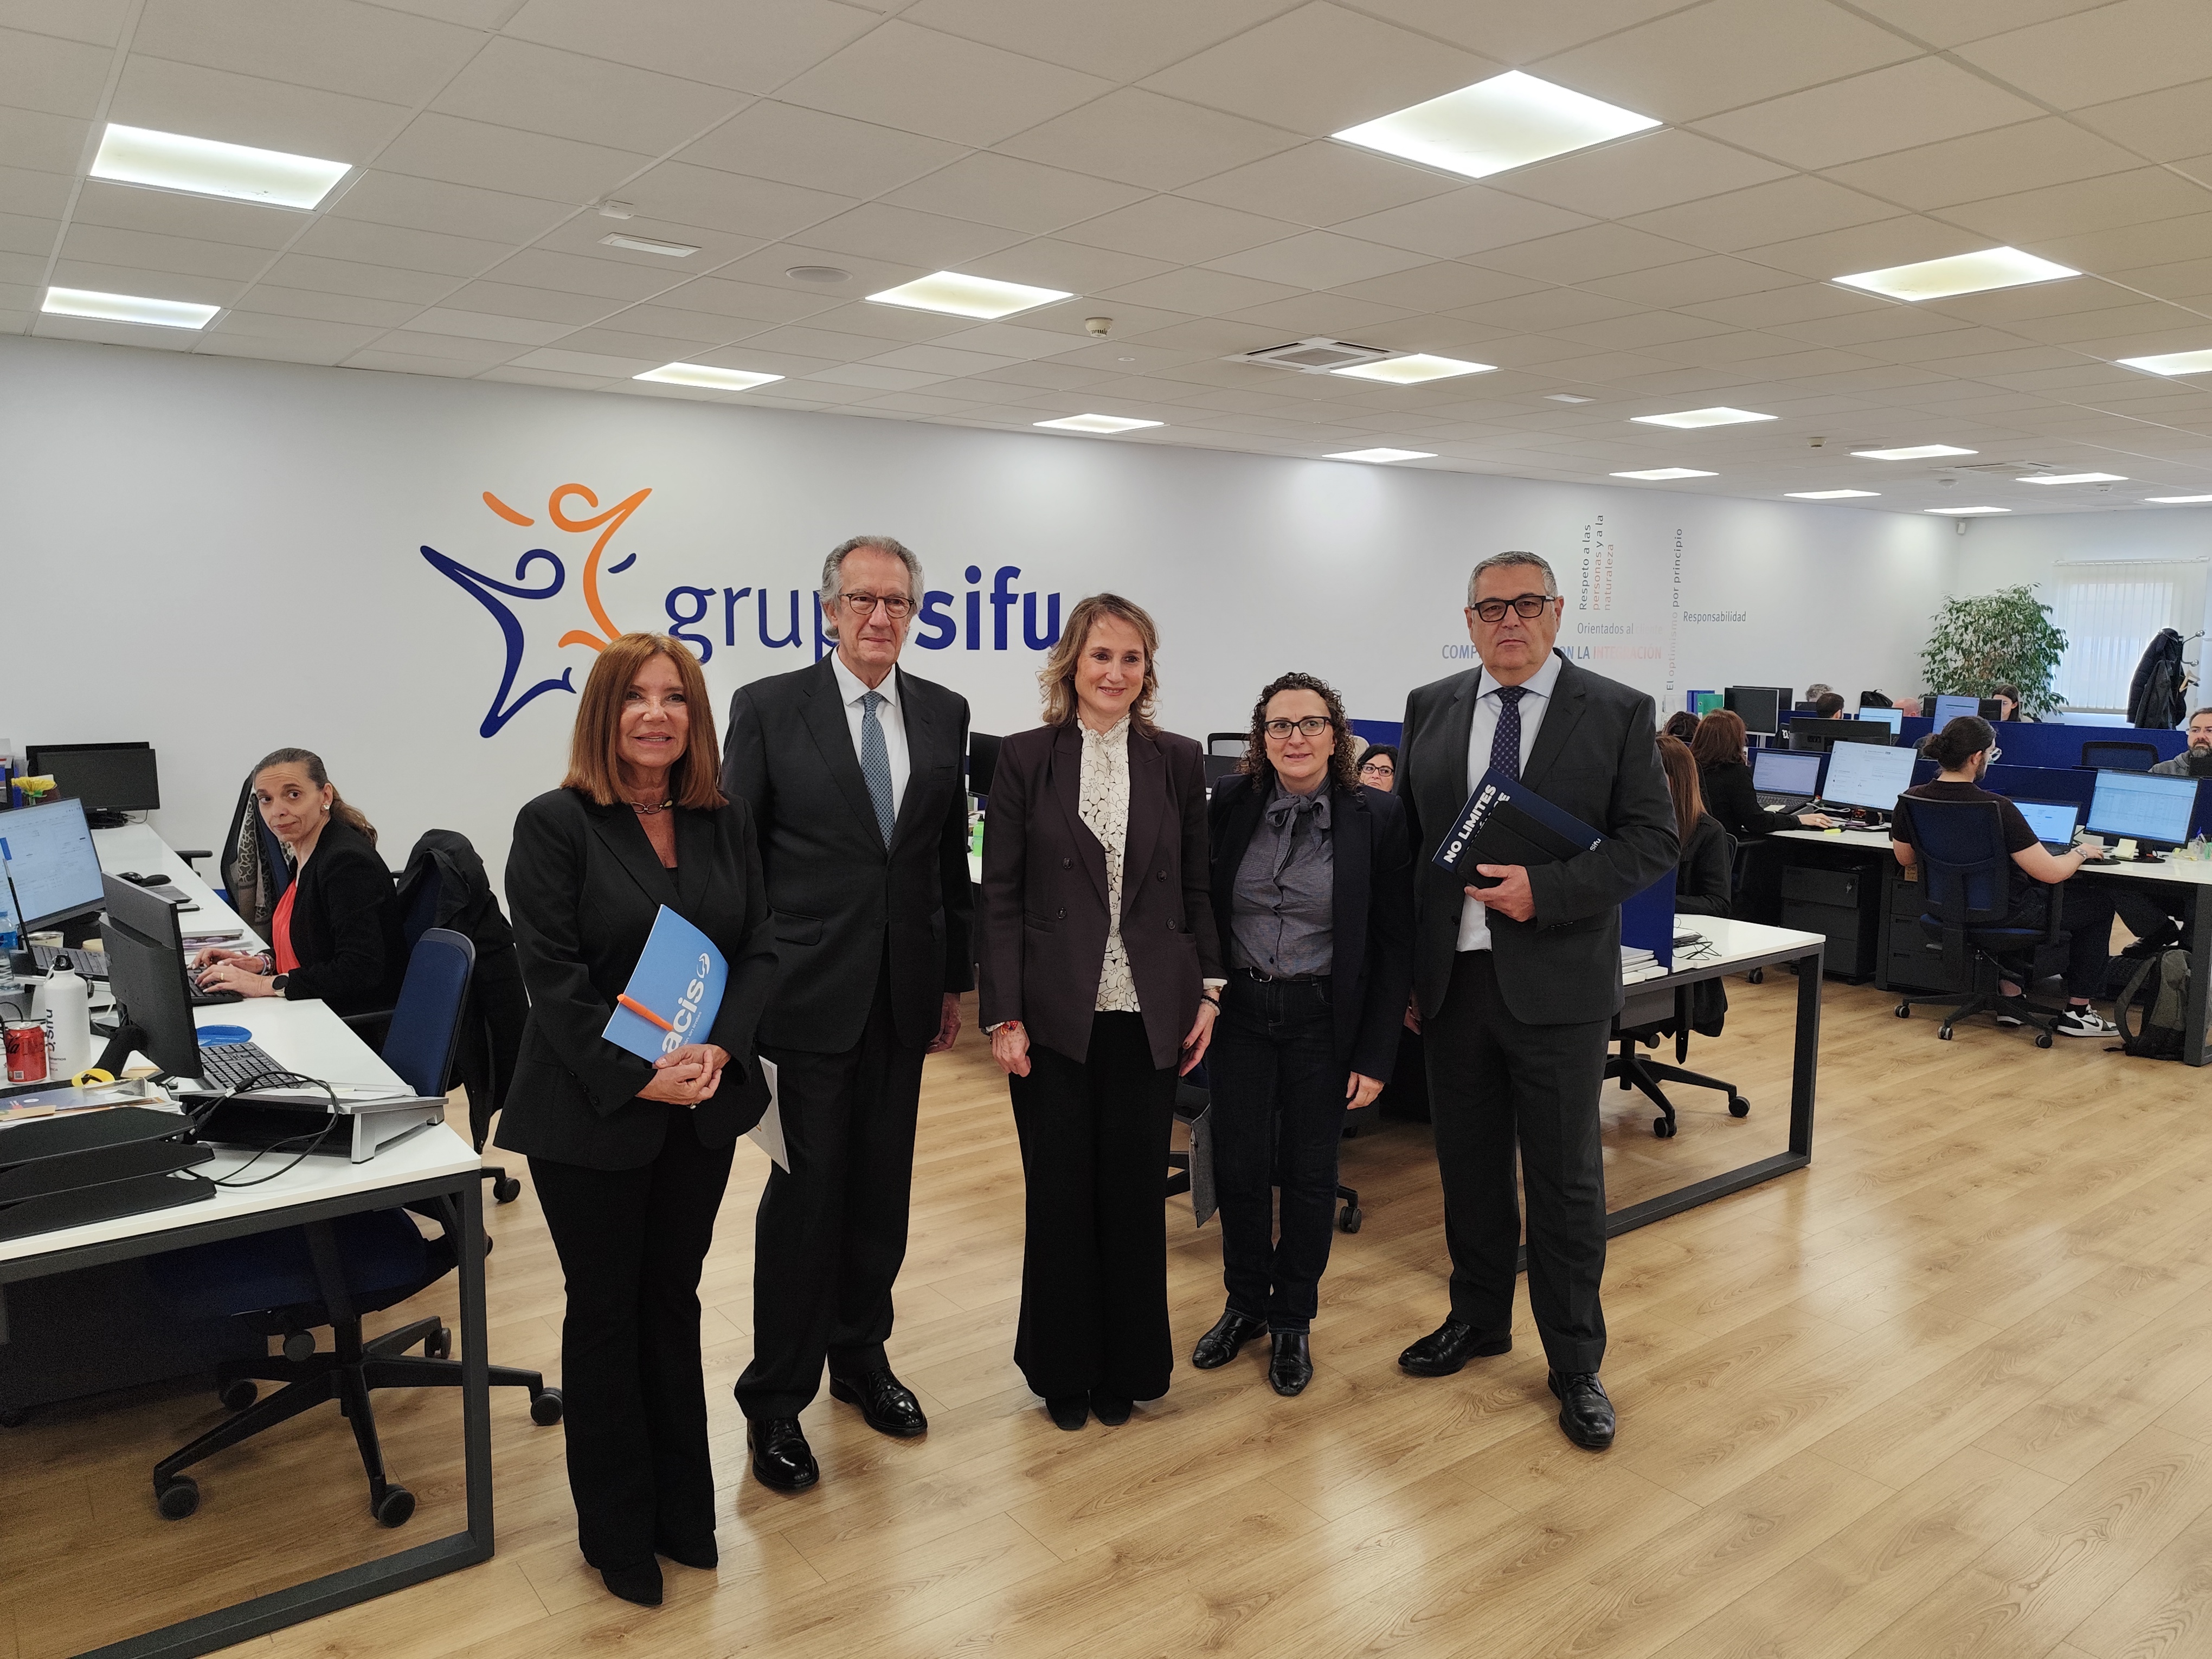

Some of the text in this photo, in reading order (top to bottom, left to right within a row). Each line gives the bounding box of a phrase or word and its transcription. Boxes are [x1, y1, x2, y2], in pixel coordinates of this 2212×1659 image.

[1595, 515, 1603, 525] la
[1582, 524, 1591, 543] las
[1673, 529, 1683, 583] principio
[1579, 558, 1590, 610] Respeto
[1593, 551, 1602, 610] personas
[1604, 544, 1613, 610] naturaleza
[1683, 610, 1746, 624] Responsabilidad
[1577, 622, 1624, 634] Orientados
[1626, 622, 1634, 634] al
[1577, 646, 1590, 659] LA
[1593, 643, 1662, 659] INTEGRACIÓN
[1668, 612, 1678, 677] optimismo
[1666, 680, 1674, 690] El
[1443, 840, 1462, 864] NO
[1458, 784, 1496, 840] LIMITES
[1590, 838, 1602, 852] Sifu
